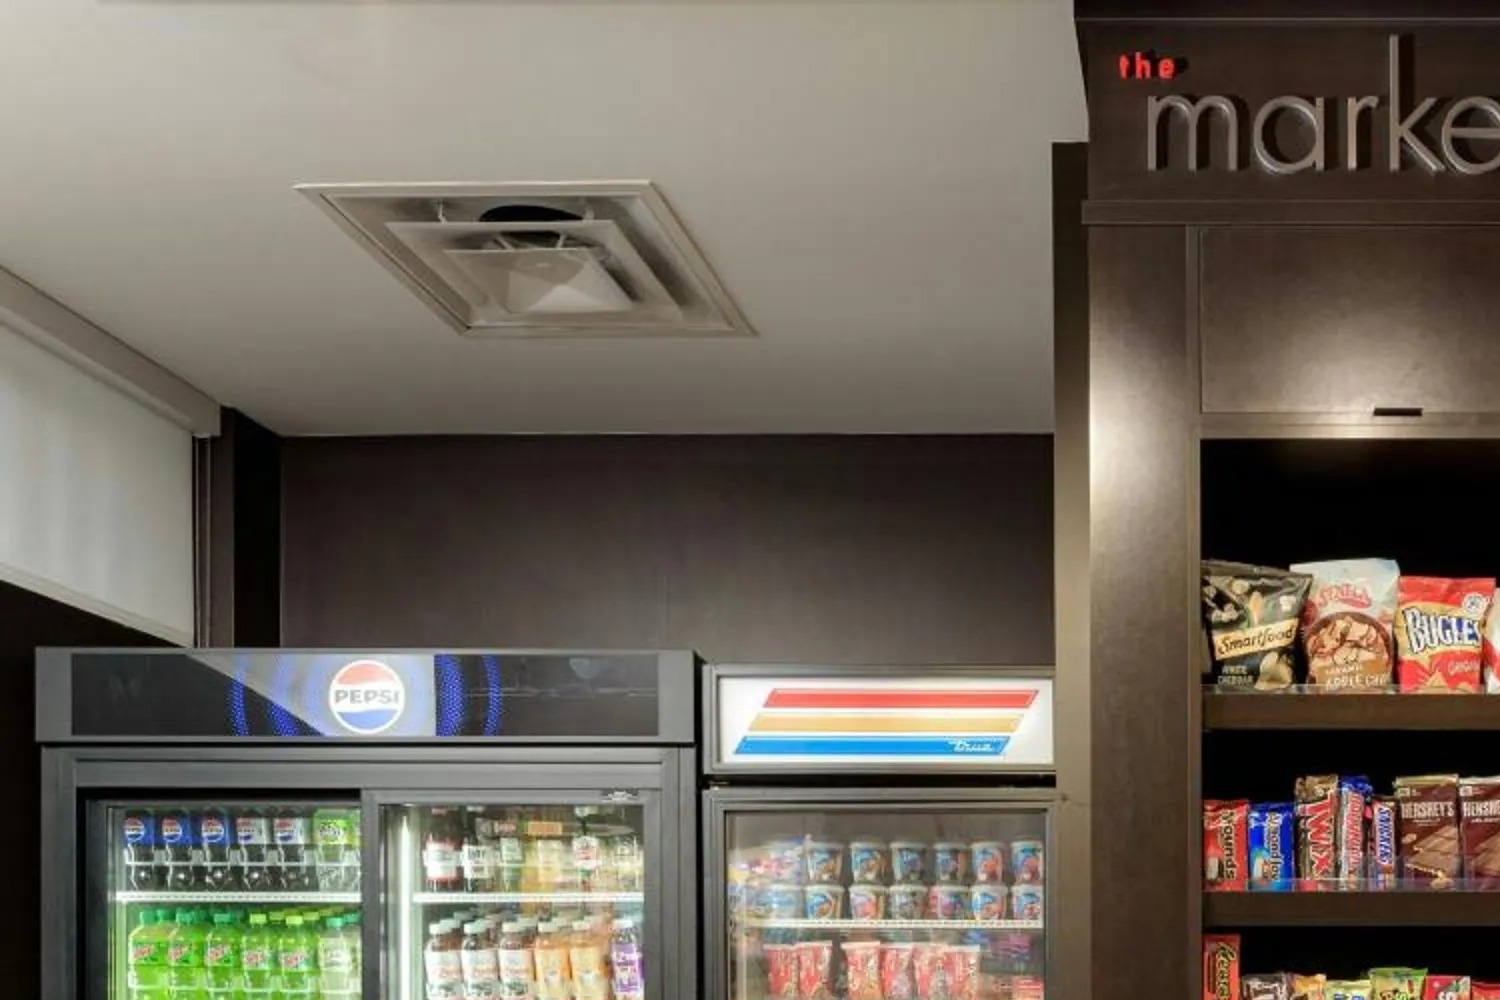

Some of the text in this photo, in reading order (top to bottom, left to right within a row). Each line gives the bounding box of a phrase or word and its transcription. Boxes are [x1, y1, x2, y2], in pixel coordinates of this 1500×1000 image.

[1119, 53, 1175, 80] the
[1218, 624, 1296, 656] Smartfood
[1401, 606, 1480, 655] BUGLE
[335, 689, 400, 704] PEPSI
[1401, 801, 1455, 821] HERSHEY'S
[1300, 797, 1333, 878] TWIX
[1378, 806, 1394, 865] SNICKERS
